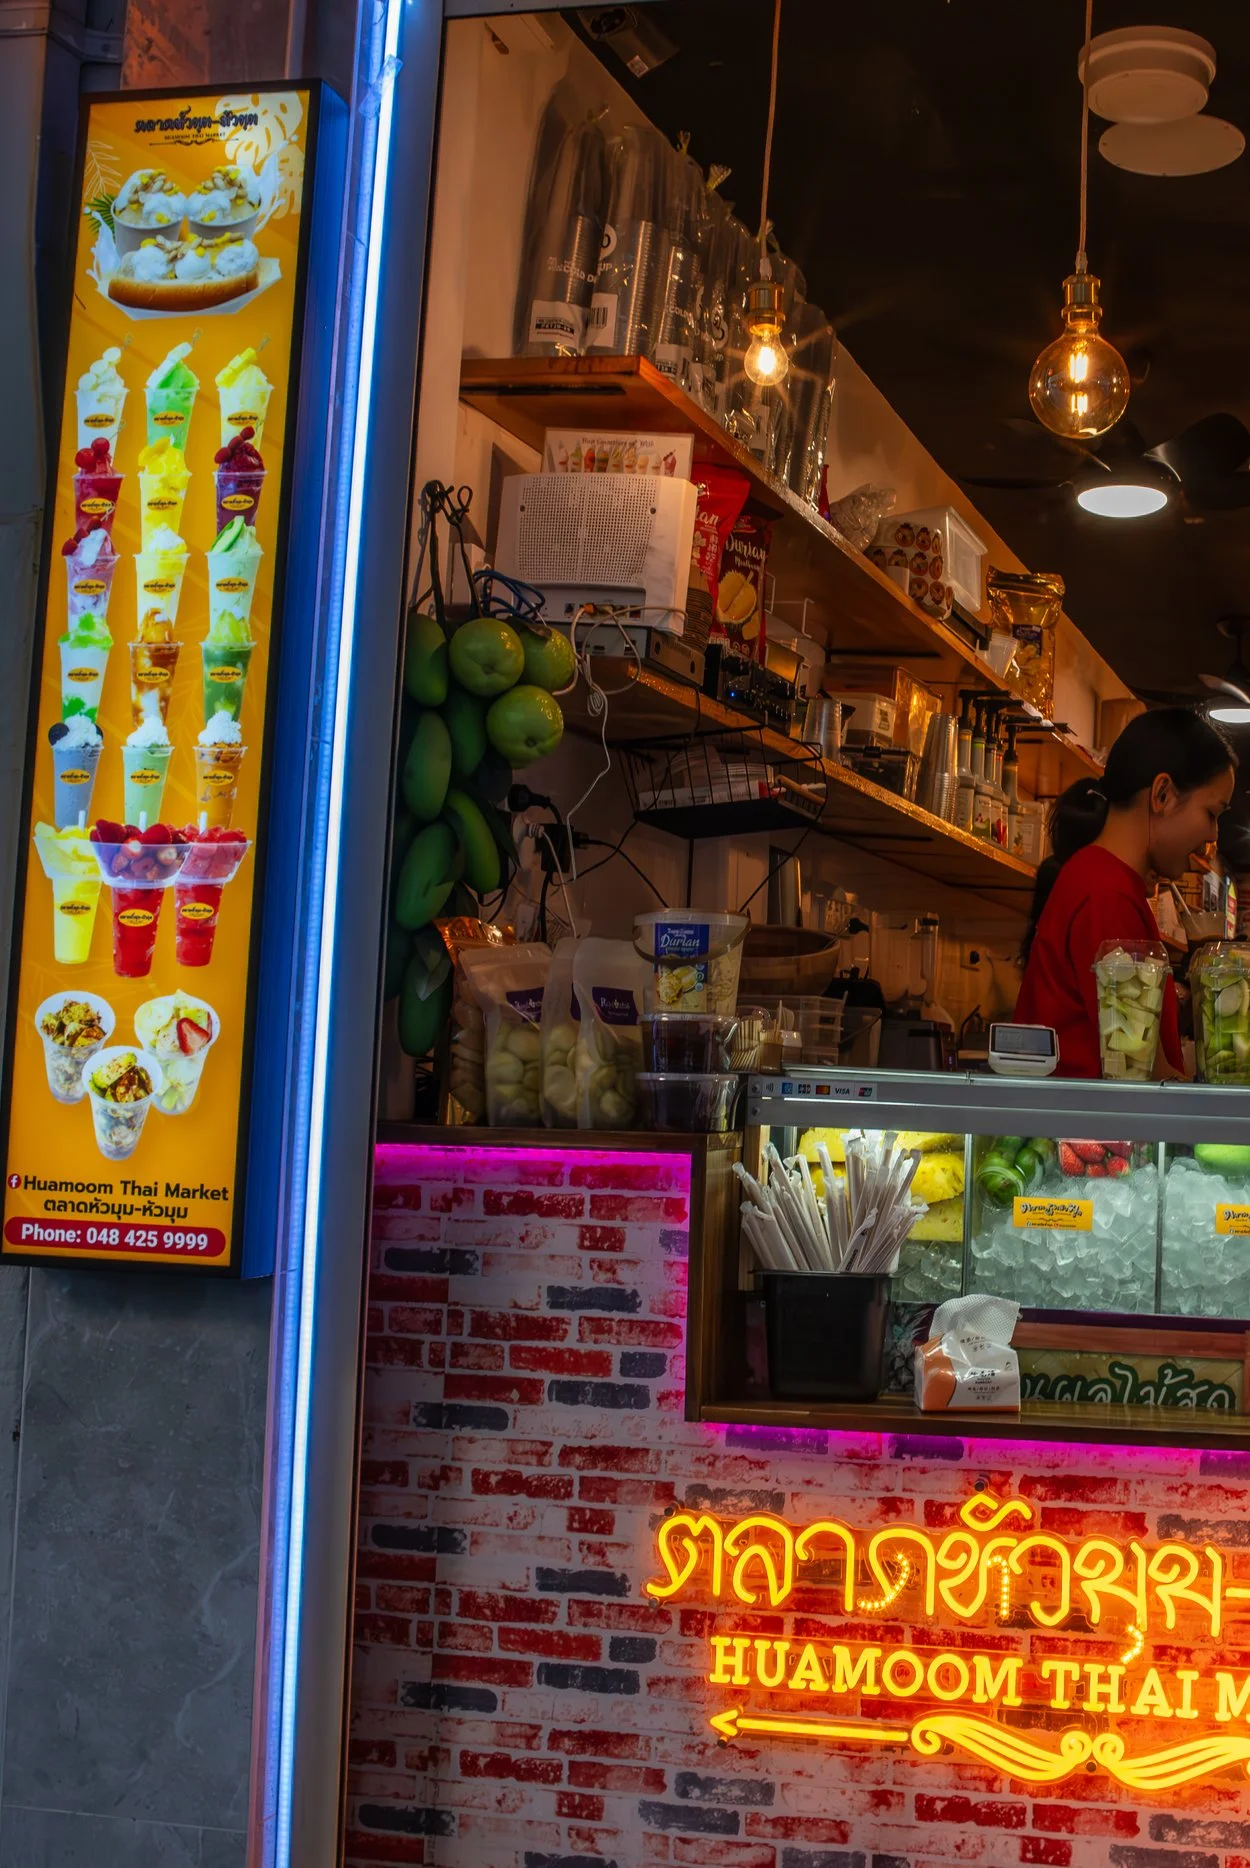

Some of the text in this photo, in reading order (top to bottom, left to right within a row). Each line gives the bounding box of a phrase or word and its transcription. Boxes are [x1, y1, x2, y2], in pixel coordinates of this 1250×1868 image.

[660, 933, 701, 949] Durian
[834, 1087, 851, 1096] VISA
[23, 1175, 229, 1201] Huamoom Thai Market
[43, 1197, 189, 1224] ตลาดหัวมุม-หัวมุม
[21, 1223, 209, 1250] Phone: 048 425 9999
[708, 1636, 1025, 1707] HUAMOOM
[1040, 1661, 1200, 1720] THAI
